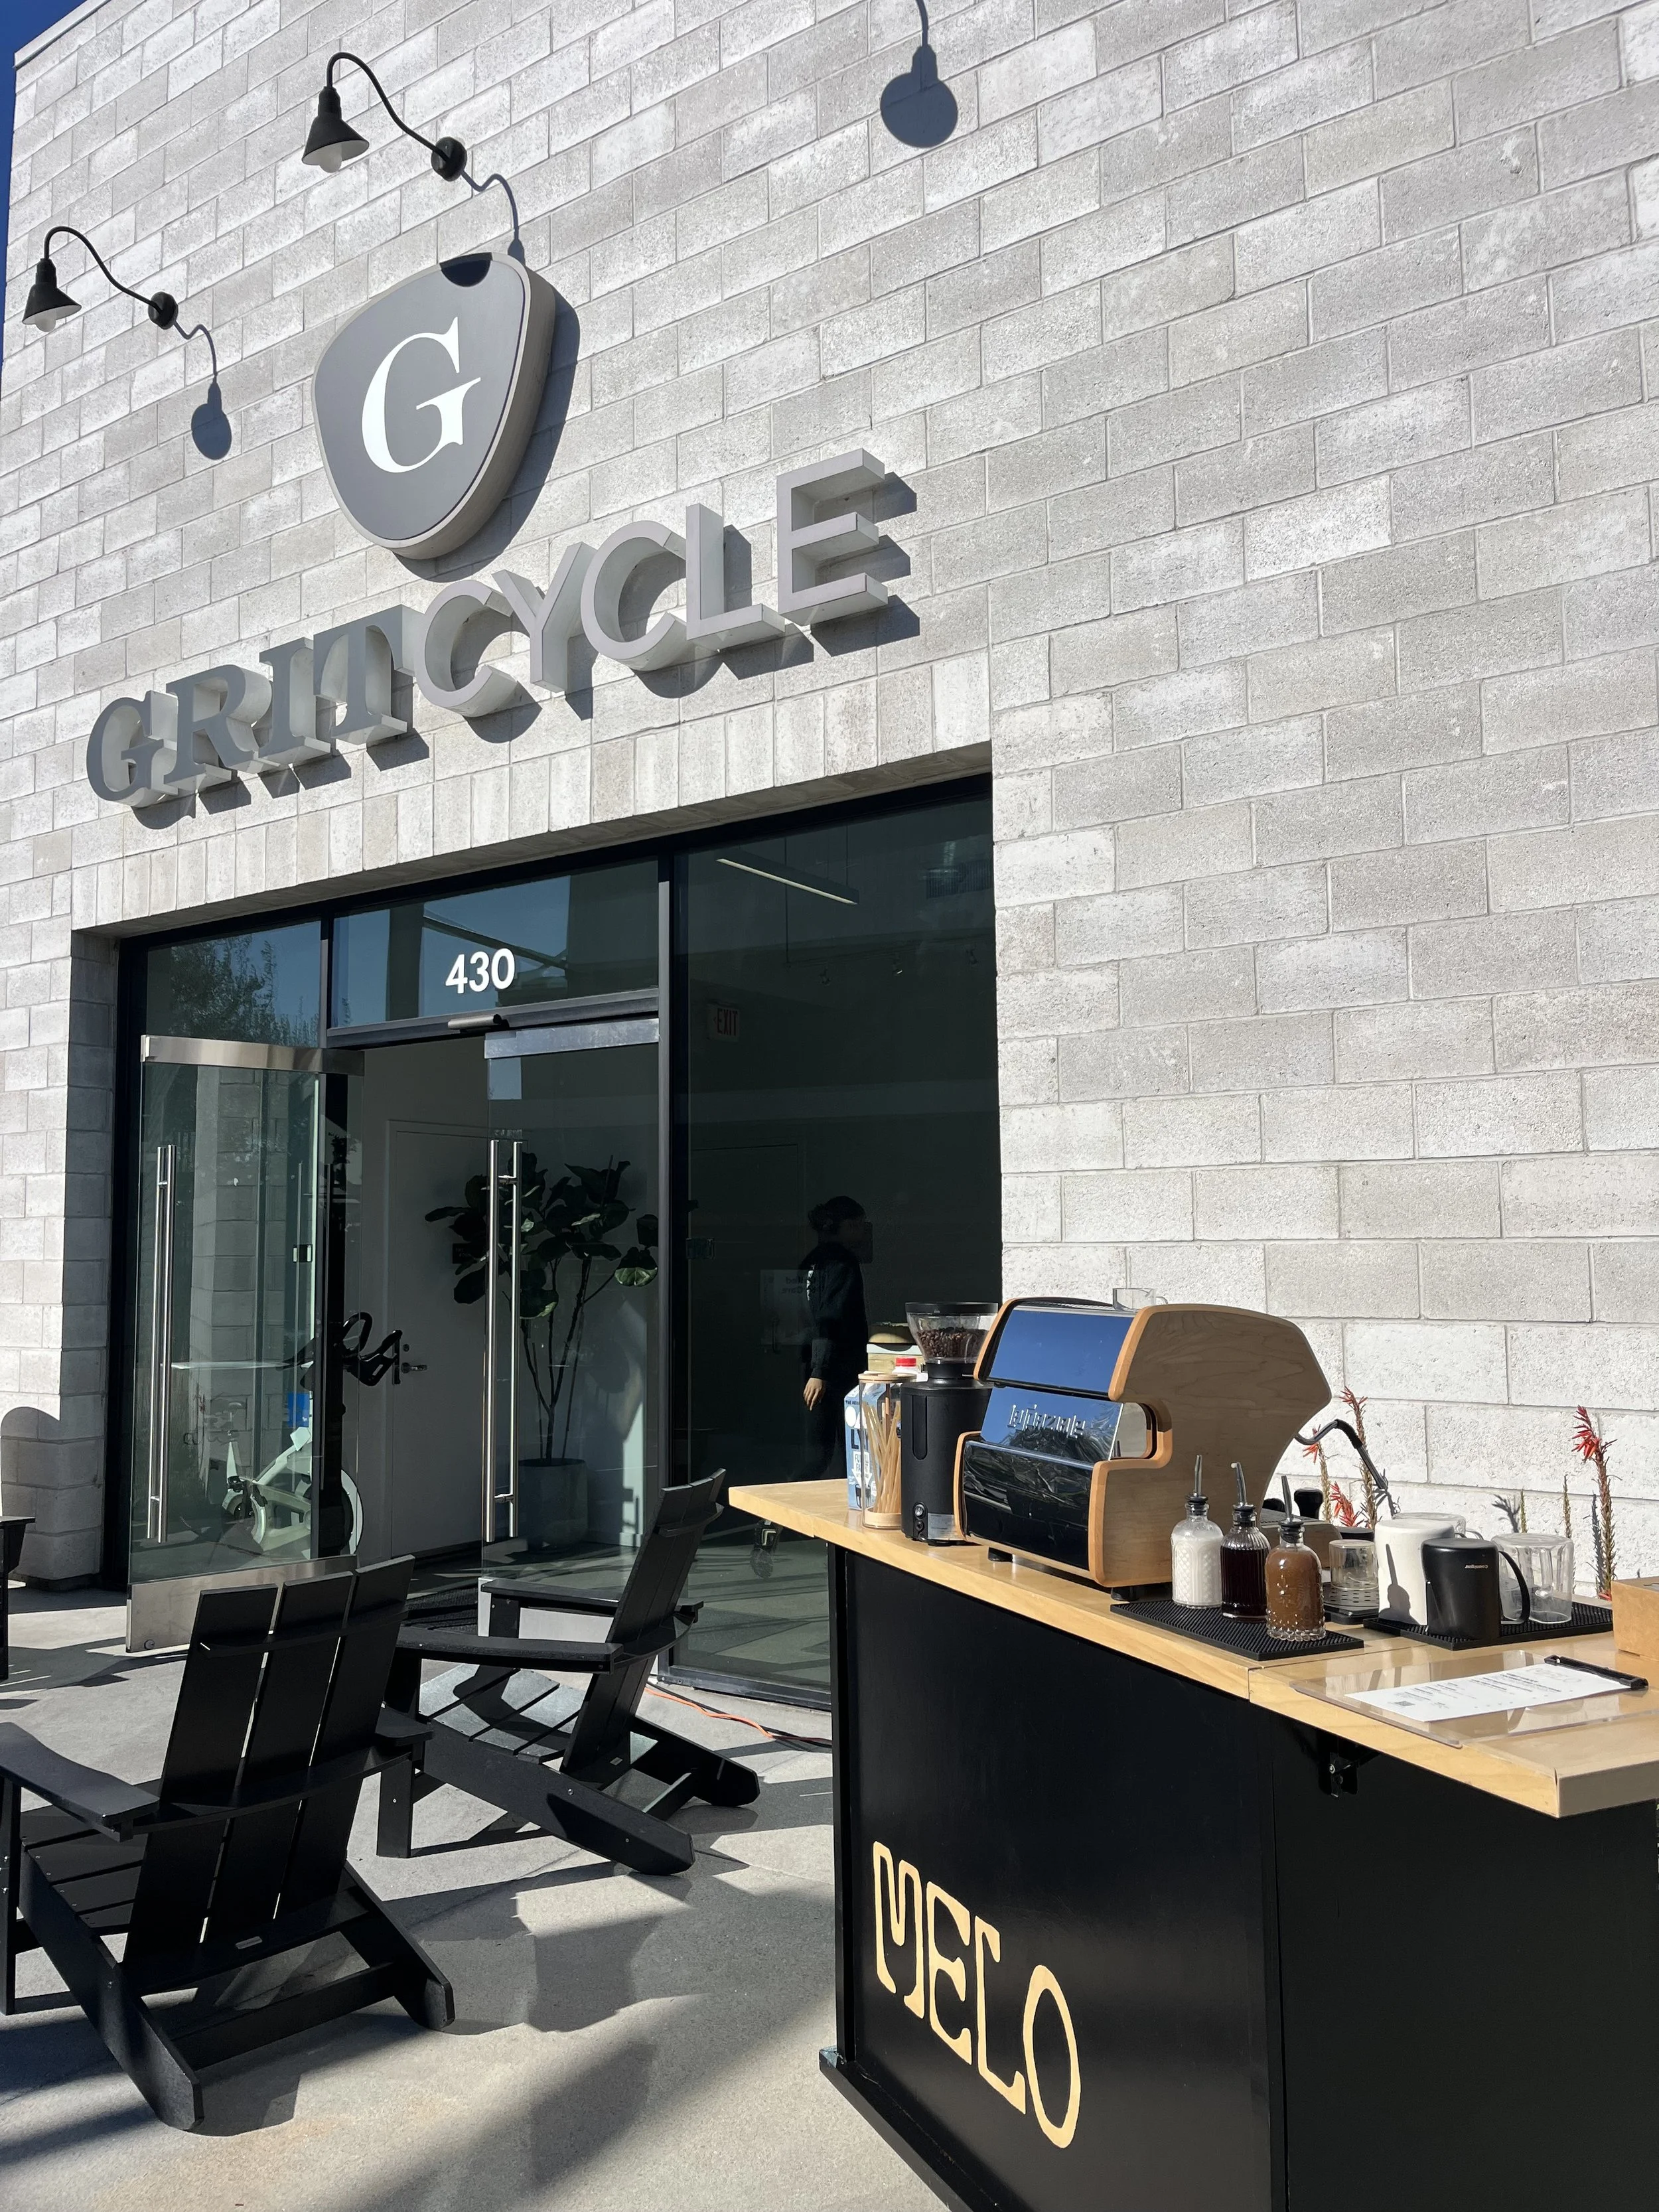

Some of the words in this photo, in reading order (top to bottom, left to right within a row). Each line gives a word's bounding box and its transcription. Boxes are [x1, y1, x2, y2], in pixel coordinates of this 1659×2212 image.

[361, 317, 481, 474] G
[87, 449, 888, 806] GRITCYCLE
[445, 948, 515, 994] 430
[717, 1008, 738, 1036] EXIT
[873, 1840, 1081, 2148] MELO
